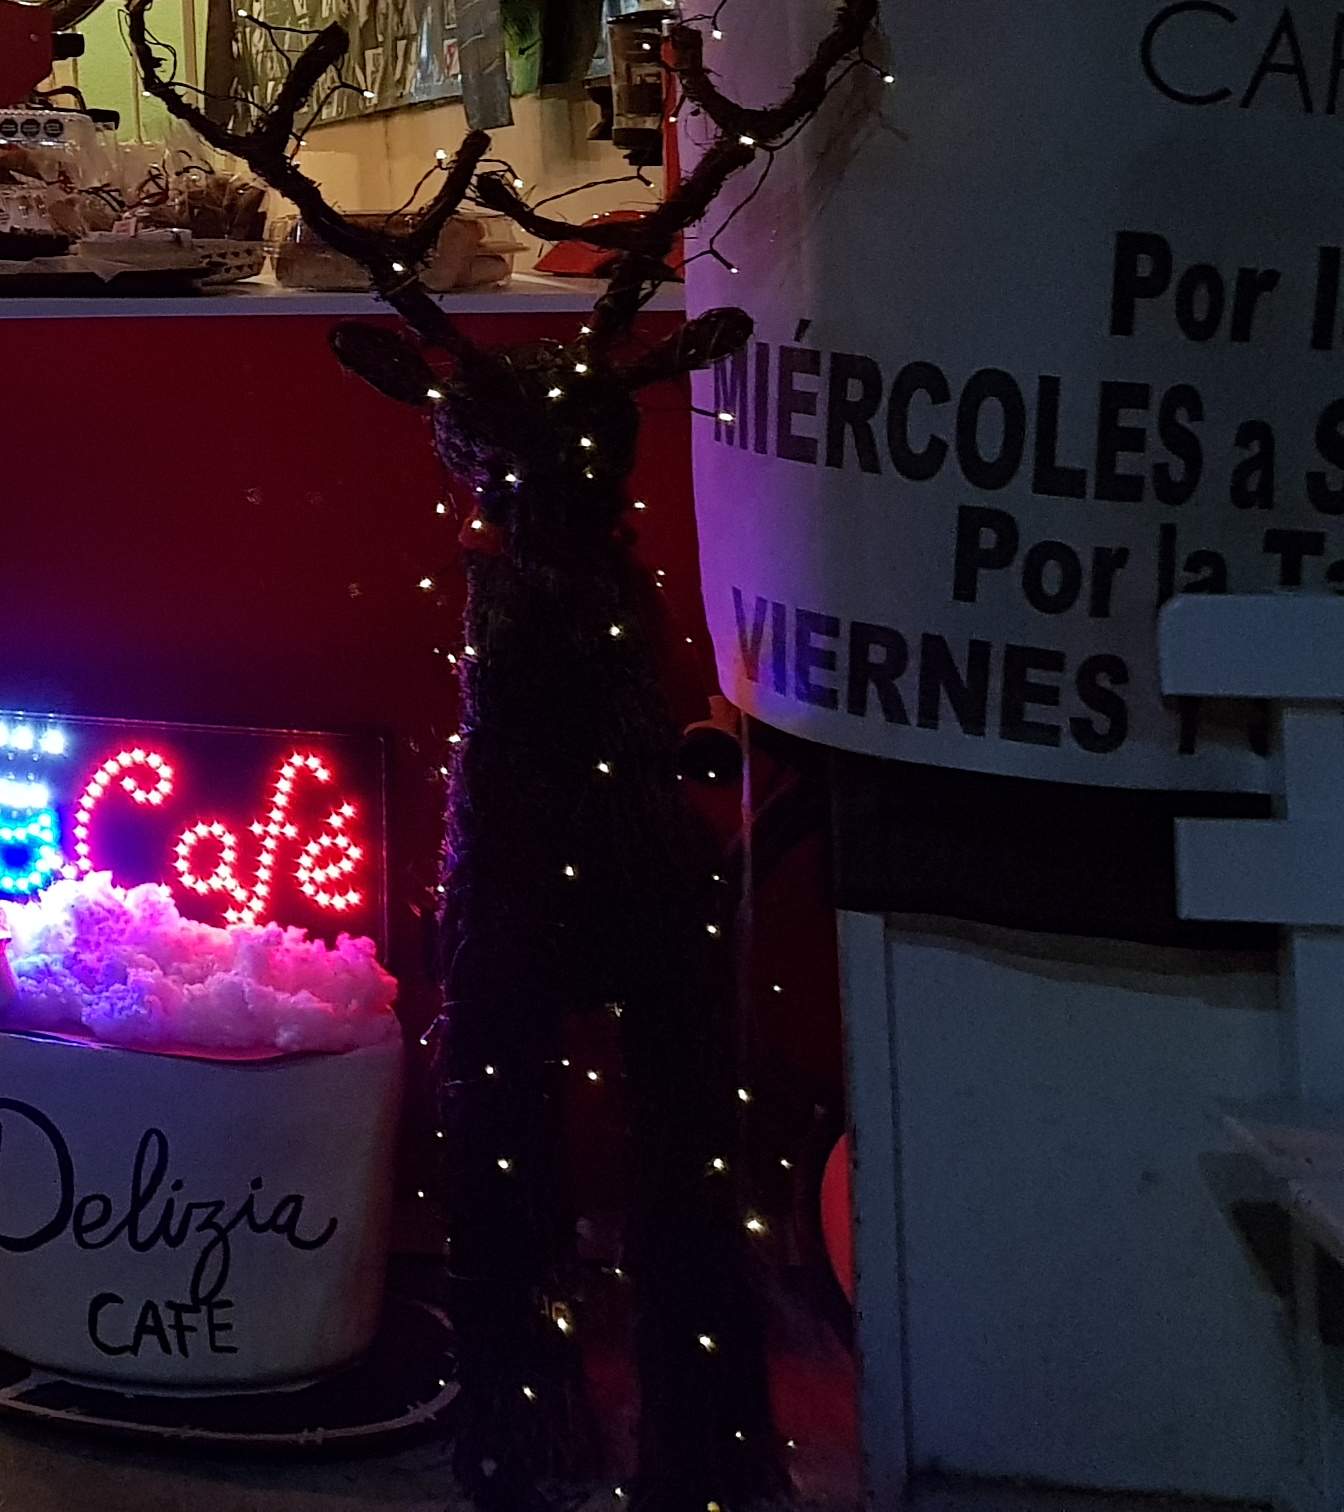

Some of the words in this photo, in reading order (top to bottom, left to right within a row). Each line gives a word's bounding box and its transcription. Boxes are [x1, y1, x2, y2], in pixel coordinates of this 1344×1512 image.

[1111, 230, 1282, 343] Por
[714, 320, 1204, 507] MIÉRCOLES
[1229, 418, 1276, 511] a
[952, 503, 1130, 618] Por
[732, 586, 1130, 755] VIERNES
[70, 745, 366, 926] Café
[86, 1291, 239, 1358] CAFE
